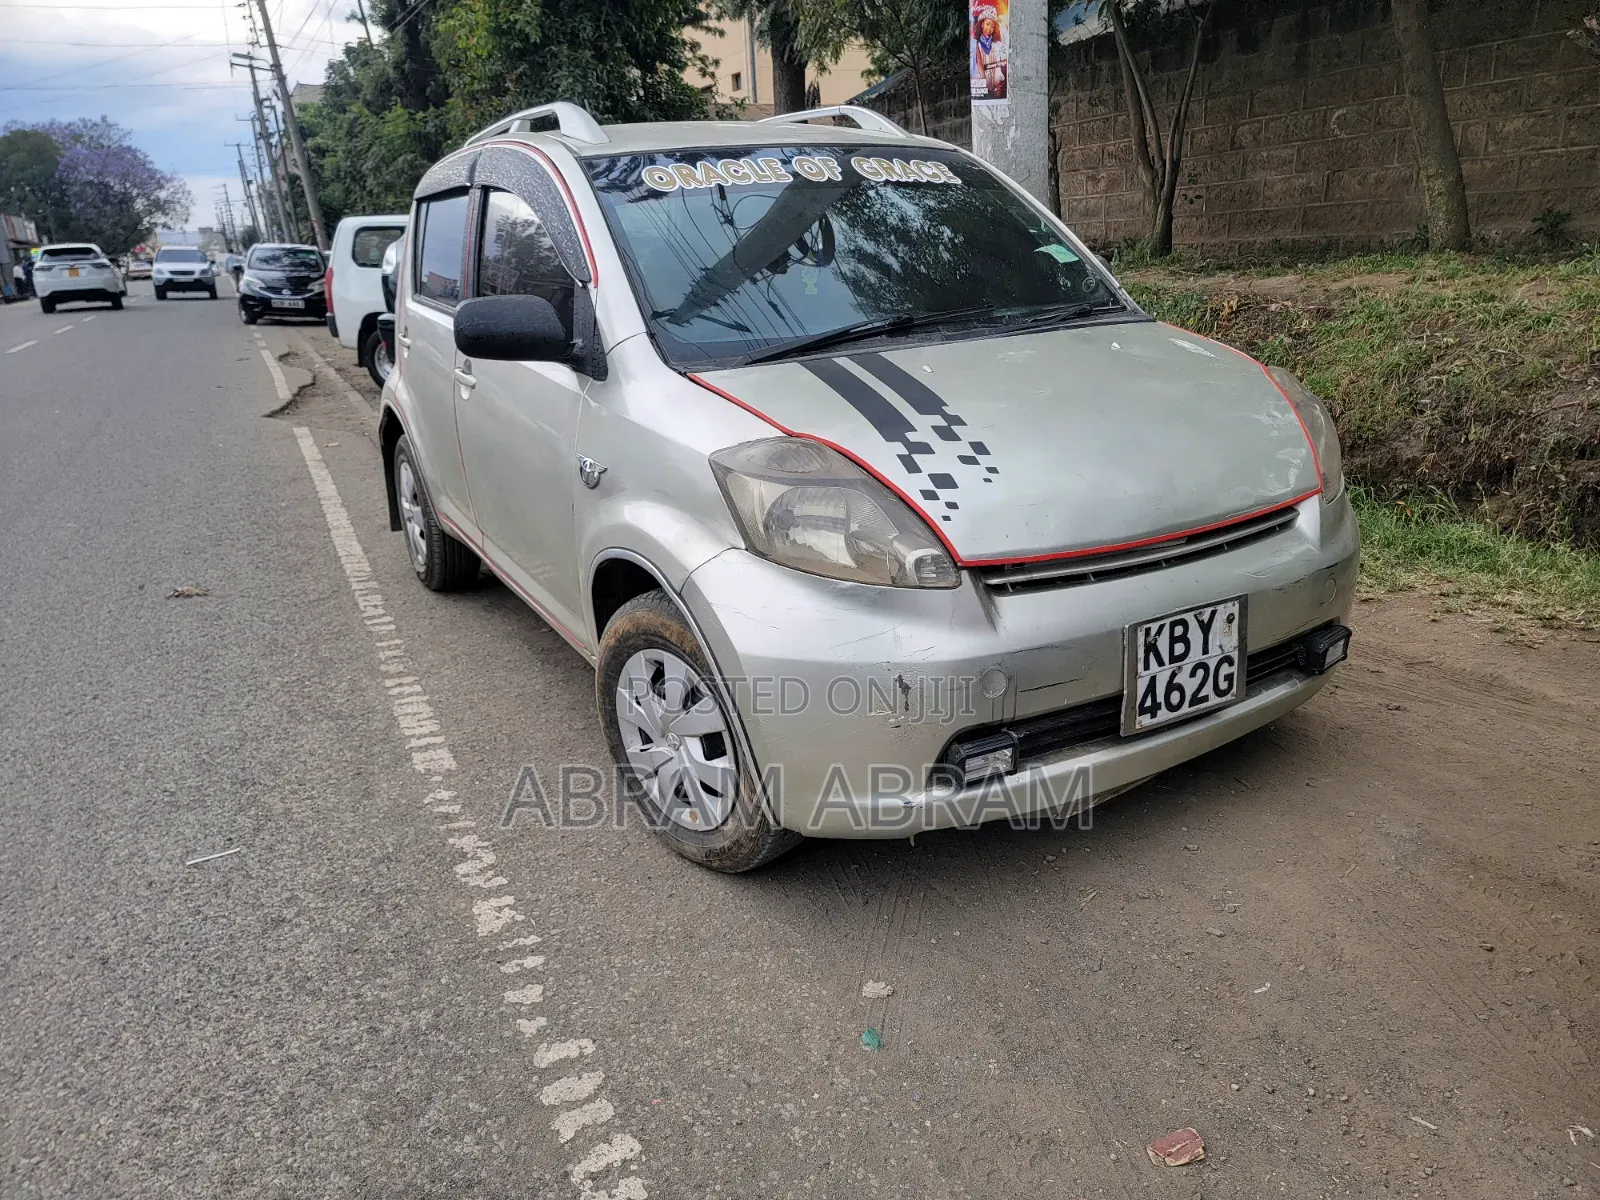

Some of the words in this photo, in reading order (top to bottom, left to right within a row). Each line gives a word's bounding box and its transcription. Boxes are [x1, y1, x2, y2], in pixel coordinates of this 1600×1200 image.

[642, 157, 793, 192] ORACLE
[791, 156, 843, 182] OF
[851, 157, 962, 184] GRACE
[1143, 608, 1218, 672] KBY
[1138, 654, 1235, 719] 462G
